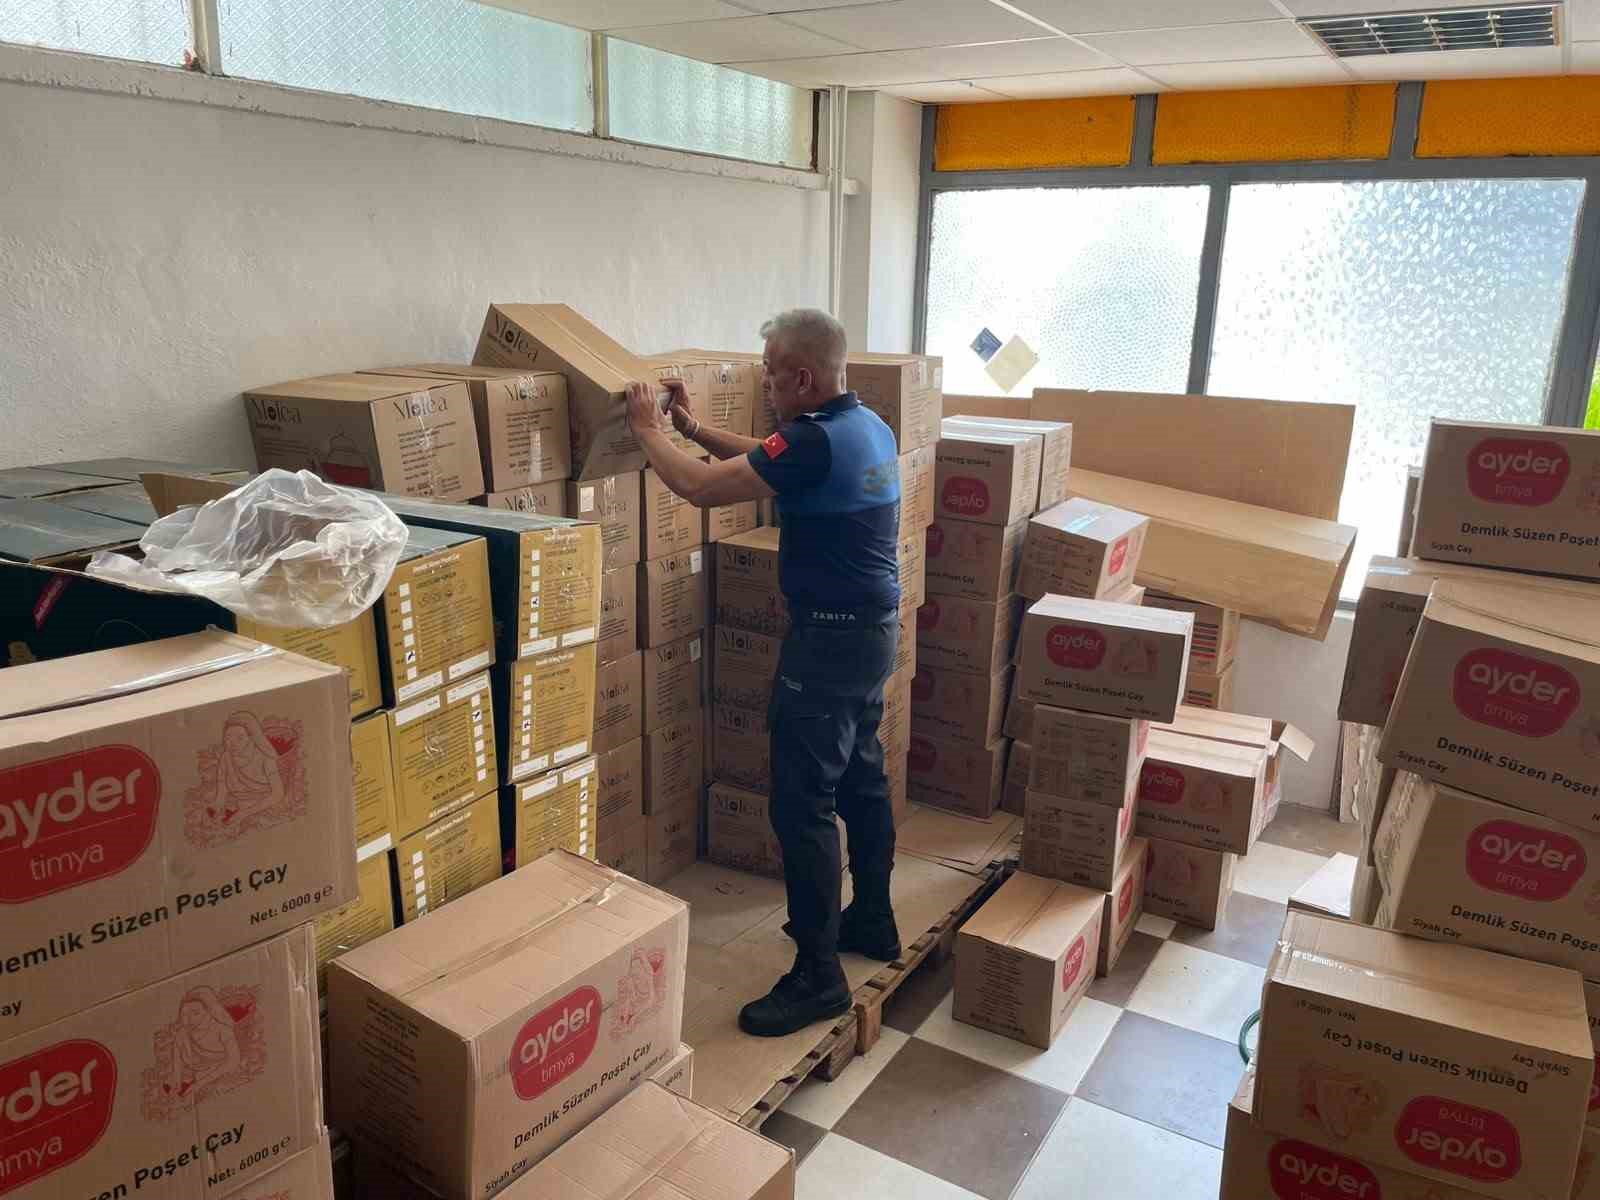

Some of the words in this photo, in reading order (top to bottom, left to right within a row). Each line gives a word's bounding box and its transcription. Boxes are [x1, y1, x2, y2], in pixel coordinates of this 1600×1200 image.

[1478, 450, 1564, 478] ayder
[1461, 522, 1510, 539] Demlik
[1512, 527, 1556, 543] Süzen
[811, 611, 856, 622] ZABITA
[1052, 630, 1101, 649] ayder
[1469, 662, 1570, 706] ayder
[1143, 765, 1182, 789] yder
[1437, 736, 1494, 765] Demlik
[1496, 753, 1548, 782] Süzen
[0, 768, 142, 849] ayder
[30, 841, 105, 882] timya
[1480, 833, 1577, 872] ayder
[91, 906, 169, 945] Süzen
[175, 878, 243, 916] Poşet
[248, 863, 288, 899] Çay
[250, 906, 278, 926] Net:
[281, 892, 311, 914] 6000
[1451, 904, 1506, 930] Demlik
[1509, 919, 1557, 943] Süzen
[1560, 932, 1600, 954] Poşe
[0, 999, 22, 1017] ay
[520, 997, 595, 1064] ayder
[1323, 1027, 1352, 1049] Çay
[1356, 1039, 1404, 1065] Poşet
[1408, 1052, 1461, 1077] Süzen
[0, 1058, 97, 1123] der
[512, 1109, 561, 1151] Demlik
[562, 1082, 599, 1115] Süzen
[600, 1054, 631, 1090] Poşet
[632, 1041, 652, 1068] Çay
[1465, 1067, 1529, 1095] Demlik
[134, 1146, 200, 1190] Poşet
[205, 1120, 246, 1154] Çay
[207, 1168, 236, 1188] Net:
[239, 1147, 270, 1172] 6000
[1405, 1125, 1508, 1170] ayder
[1279, 1152, 1374, 1200] ayder
